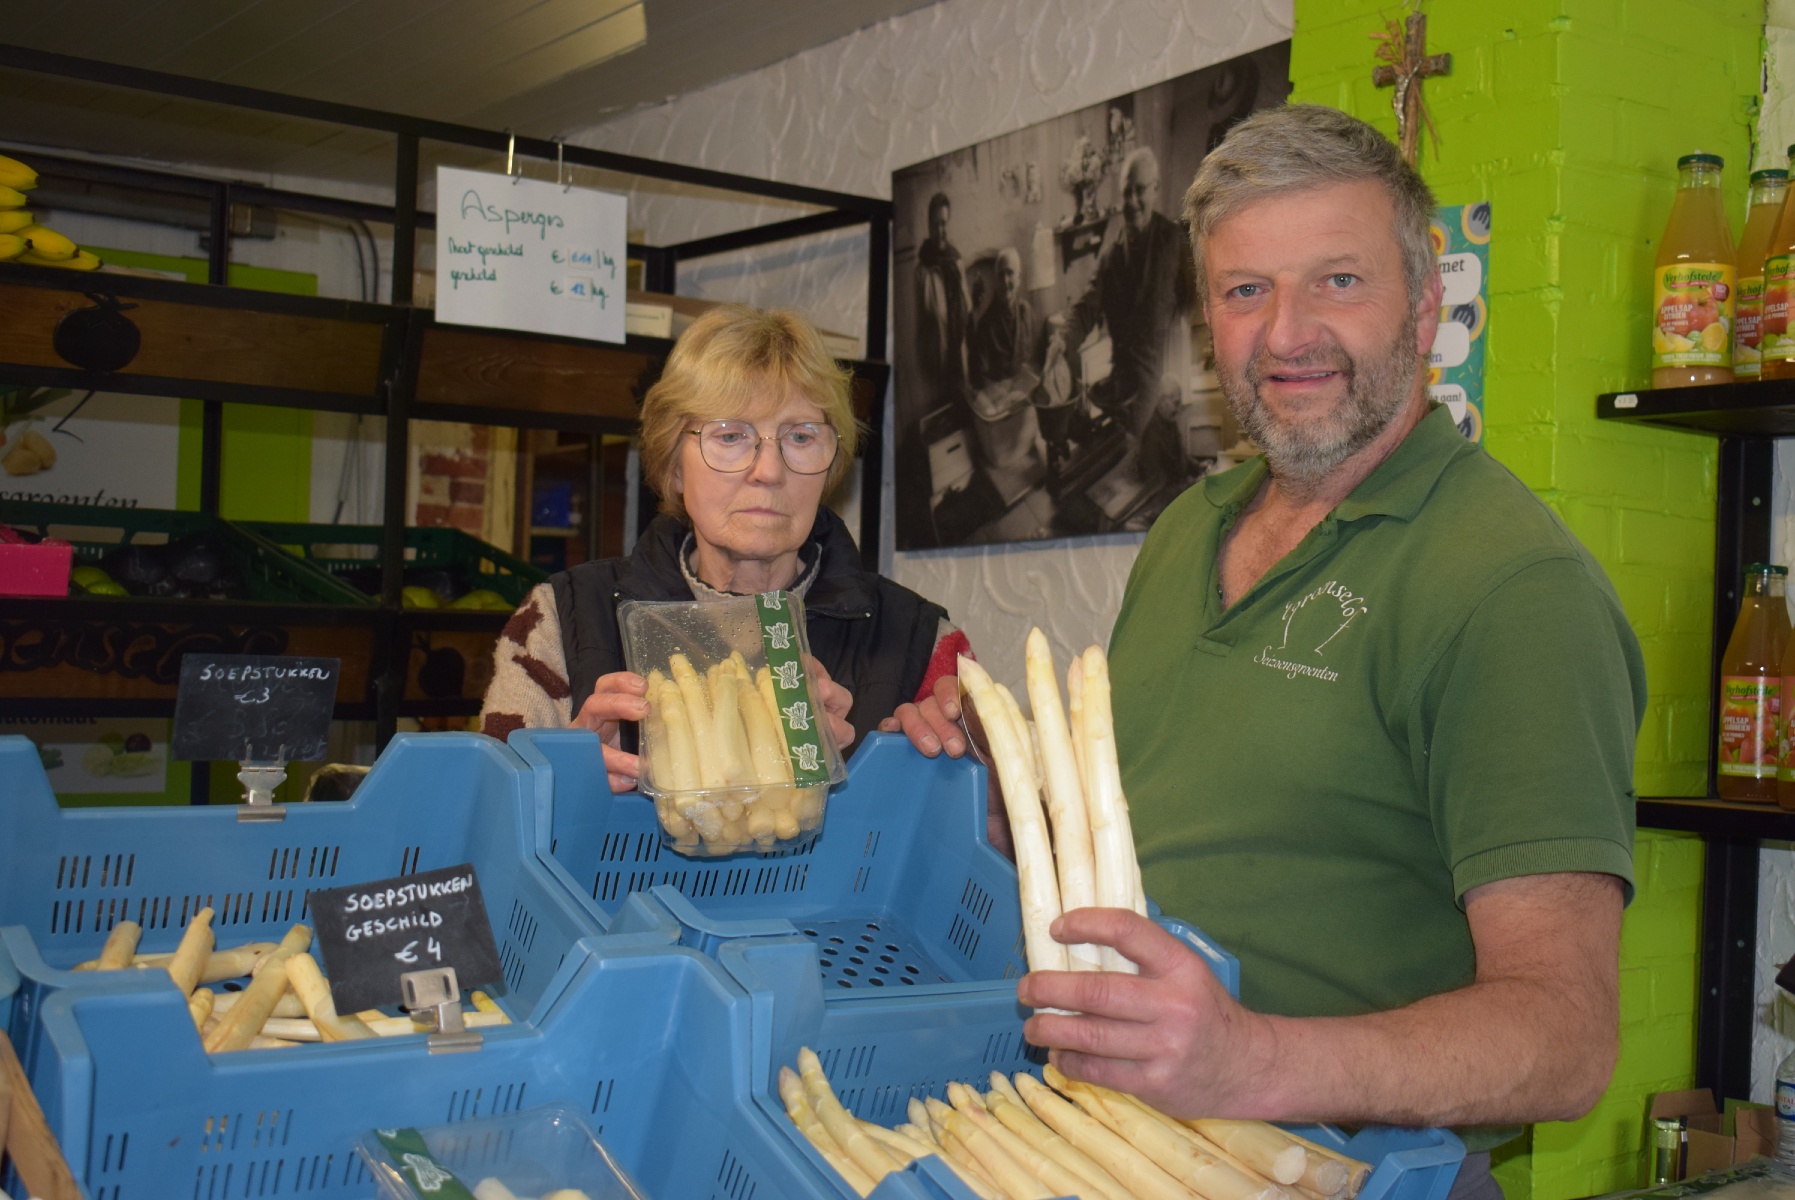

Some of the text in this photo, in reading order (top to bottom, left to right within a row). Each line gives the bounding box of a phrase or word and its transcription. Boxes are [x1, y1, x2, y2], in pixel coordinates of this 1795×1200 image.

[1664, 271, 1717, 284] Verhofstede
[1661, 304, 1693, 315] APPELSAP
[200, 663, 330, 682] SOEPSTUKKEN
[1253, 645, 1339, 682] Seizoensgroenten
[344, 873, 473, 914] SOEPSTUKKEN
[394, 937, 441, 963] € 4
